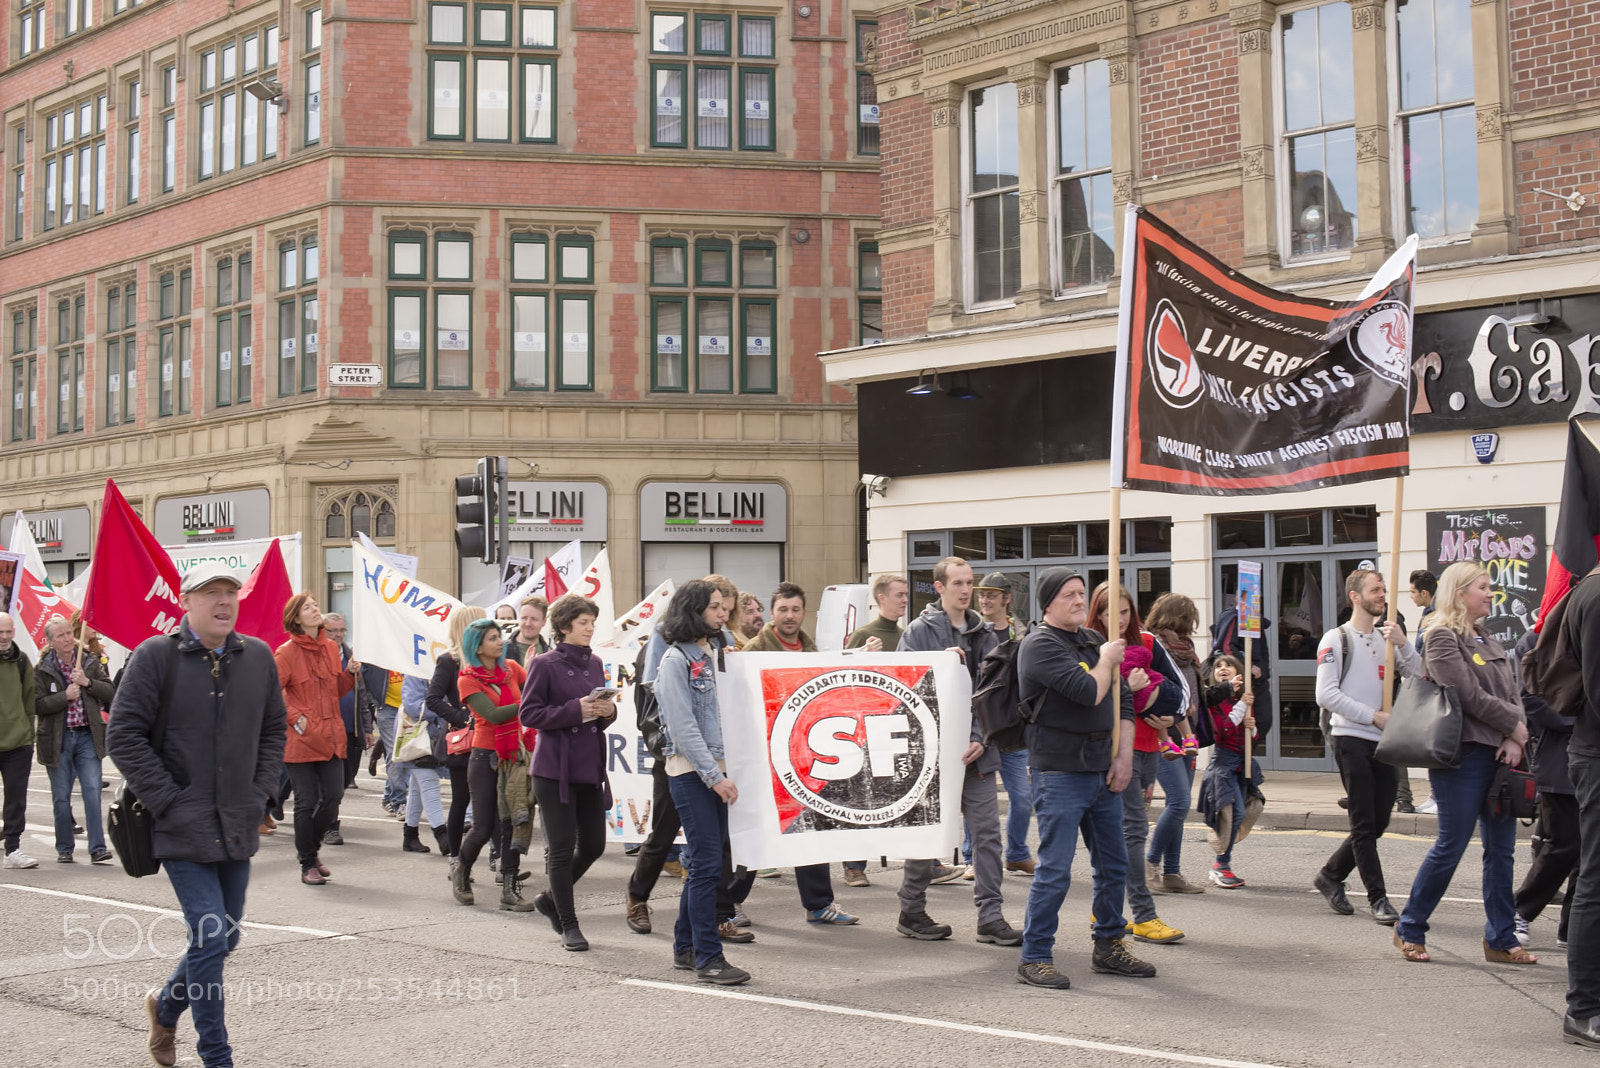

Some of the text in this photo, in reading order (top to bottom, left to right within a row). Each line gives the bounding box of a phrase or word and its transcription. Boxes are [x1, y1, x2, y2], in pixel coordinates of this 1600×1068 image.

[1167, 268, 1201, 294] fascism
[1200, 291, 1228, 308] needs
[1237, 309, 1253, 320] for
[338, 375, 373, 383] STREET
[340, 367, 371, 375] PETER
[1240, 365, 1355, 415] FASCISTS
[1157, 435, 1202, 463] WORKING
[1204, 448, 1236, 469] CLASS
[1235, 450, 1275, 468] UNITY
[1278, 435, 1335, 462] AGAINST
[1334, 423, 1384, 446] FASCISM
[1384, 421, 1404, 439] AND
[183, 501, 232, 529] BELLINI
[494, 490, 584, 518] ELLINI
[665, 491, 764, 519] BELLINI
[28, 519, 61, 542] ELLINI
[1438, 530, 1480, 562] Mr
[362, 557, 453, 623] HUMA
[787, 673, 921, 712] SOLIDARITY FEDERATION
[807, 713, 912, 781] SF
[897, 757, 909, 779] IWA
[783, 771, 851, 820] INTERNATIONAL
[853, 808, 895, 822] WORKERS
